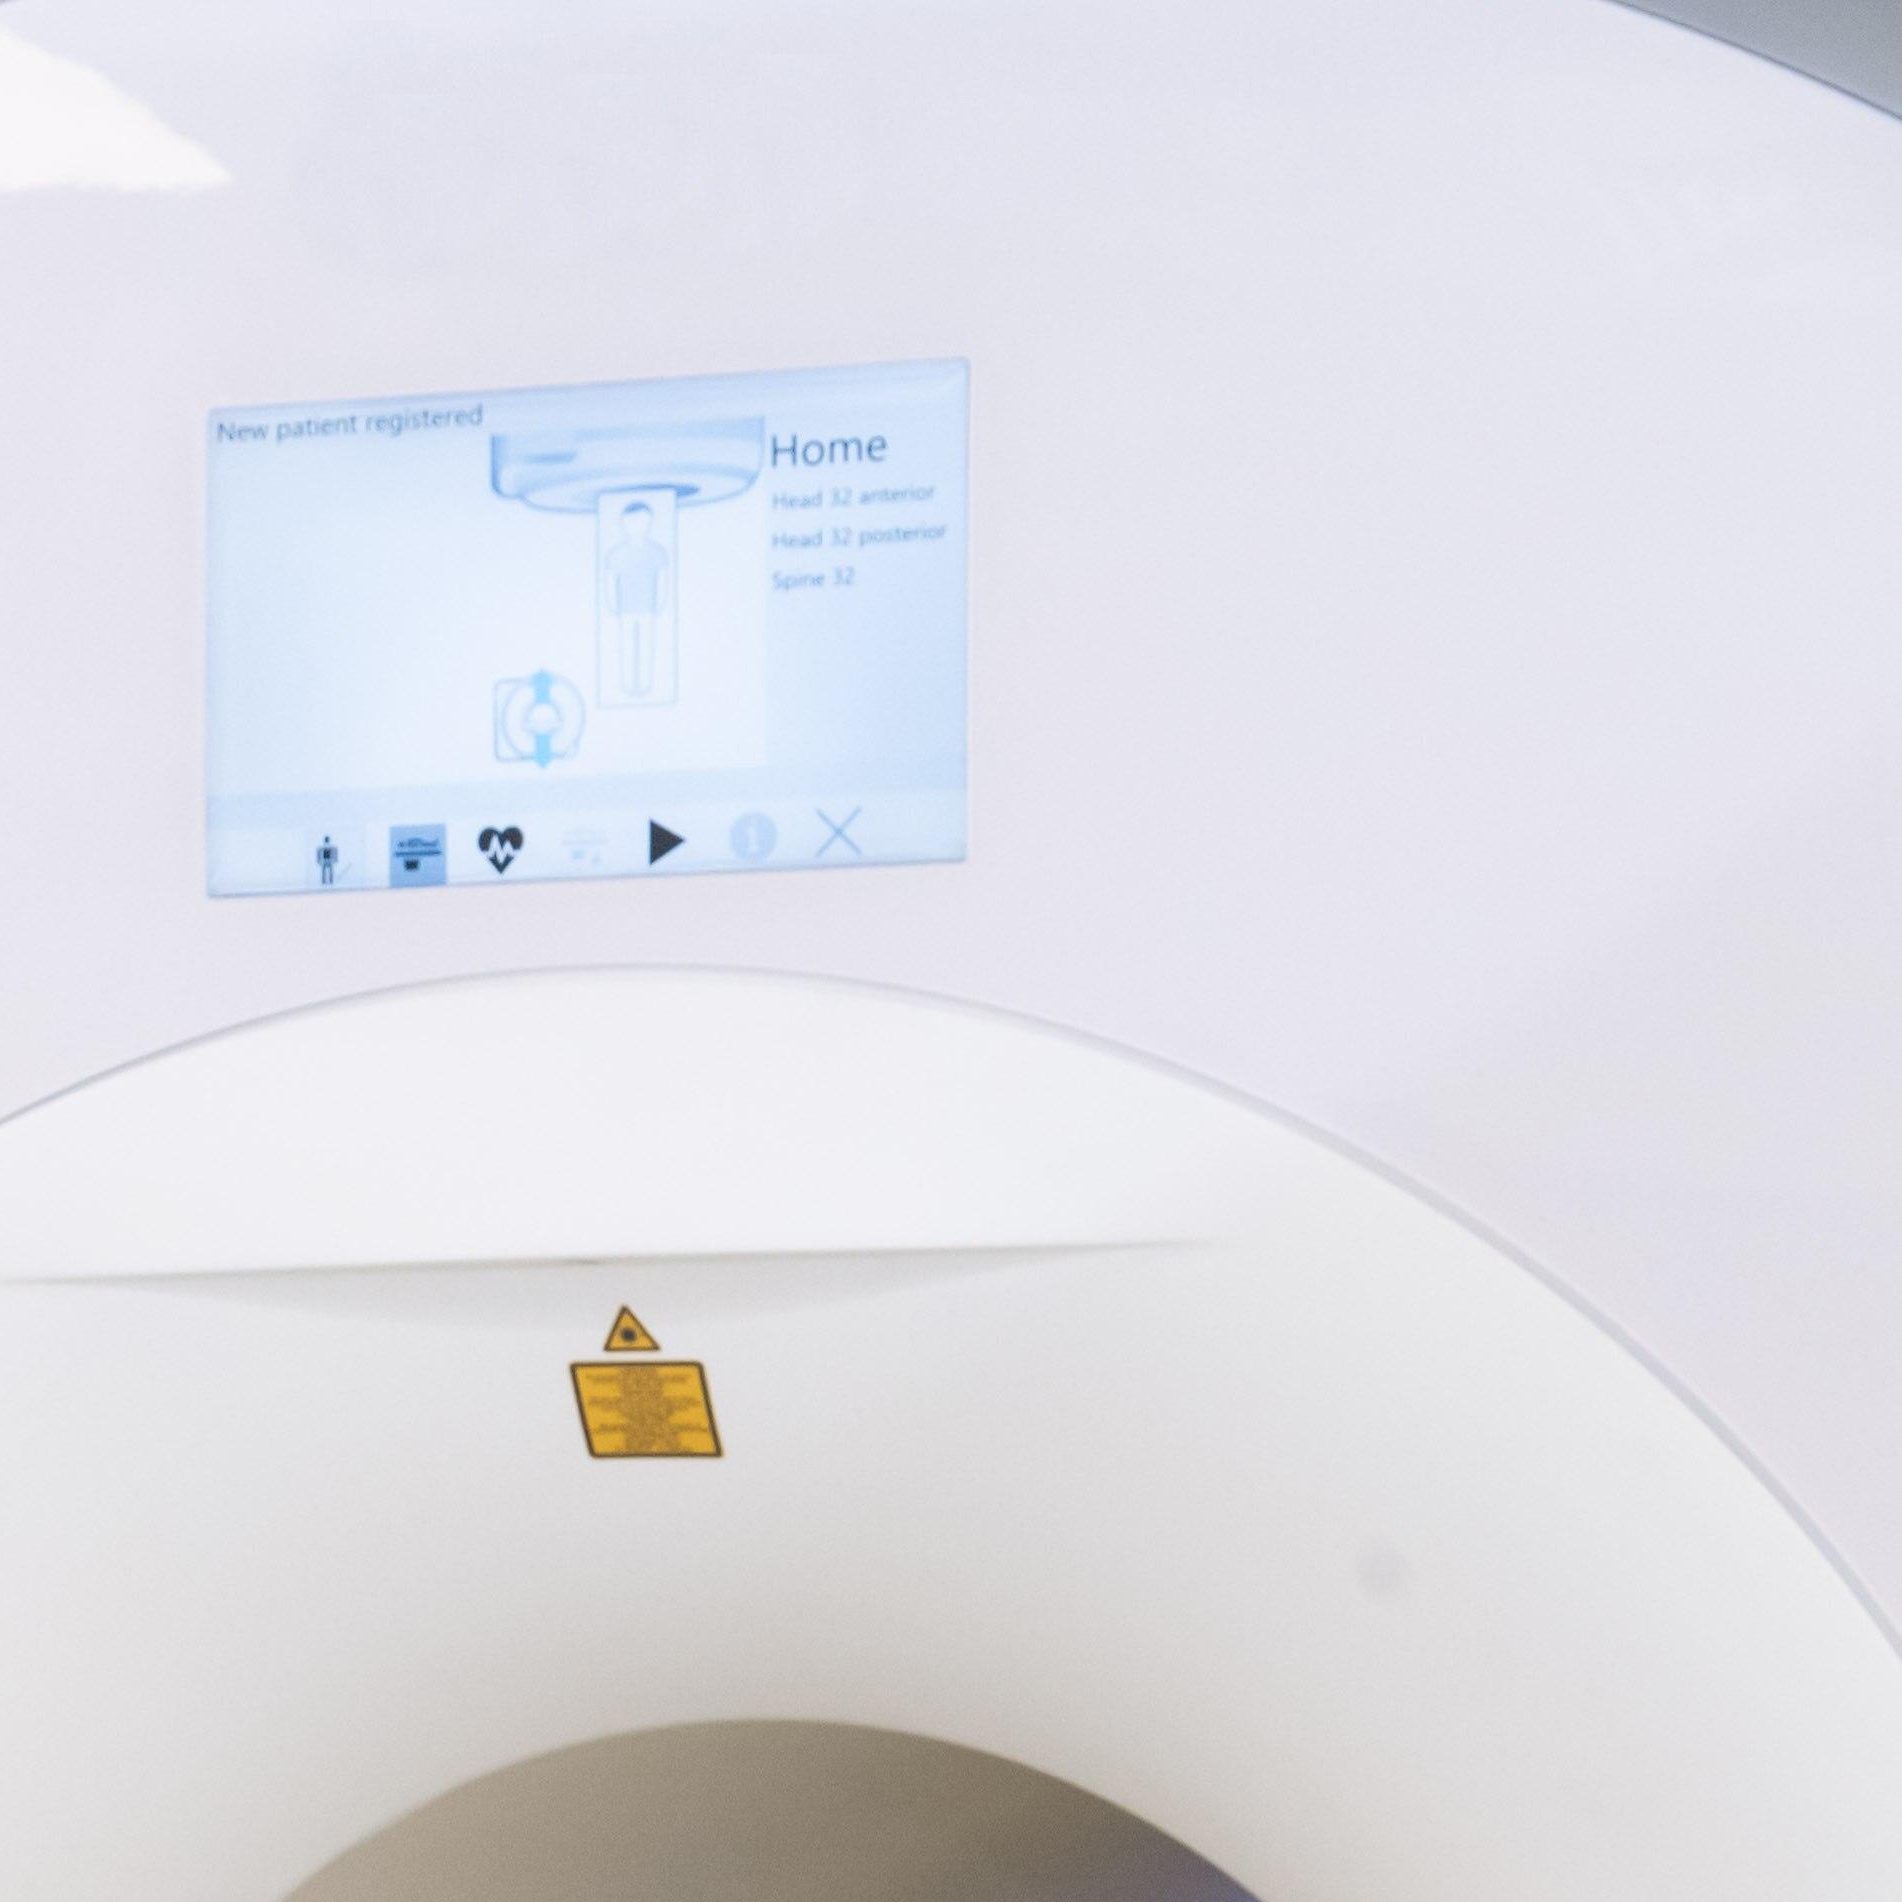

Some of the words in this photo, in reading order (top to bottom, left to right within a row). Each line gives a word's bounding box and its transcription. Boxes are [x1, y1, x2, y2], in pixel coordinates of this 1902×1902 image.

[217, 421, 269, 442] New
[275, 414, 357, 444] patient
[365, 403, 484, 438] registered
[771, 432, 889, 468] Home
[772, 490, 823, 510] Head
[832, 486, 853, 507] 32
[859, 484, 935, 506] anterior
[772, 529, 823, 549] Head
[832, 527, 852, 547] 32
[859, 523, 947, 548] posterior
[772, 570, 825, 592] Spine
[834, 565, 856, 587] 32
